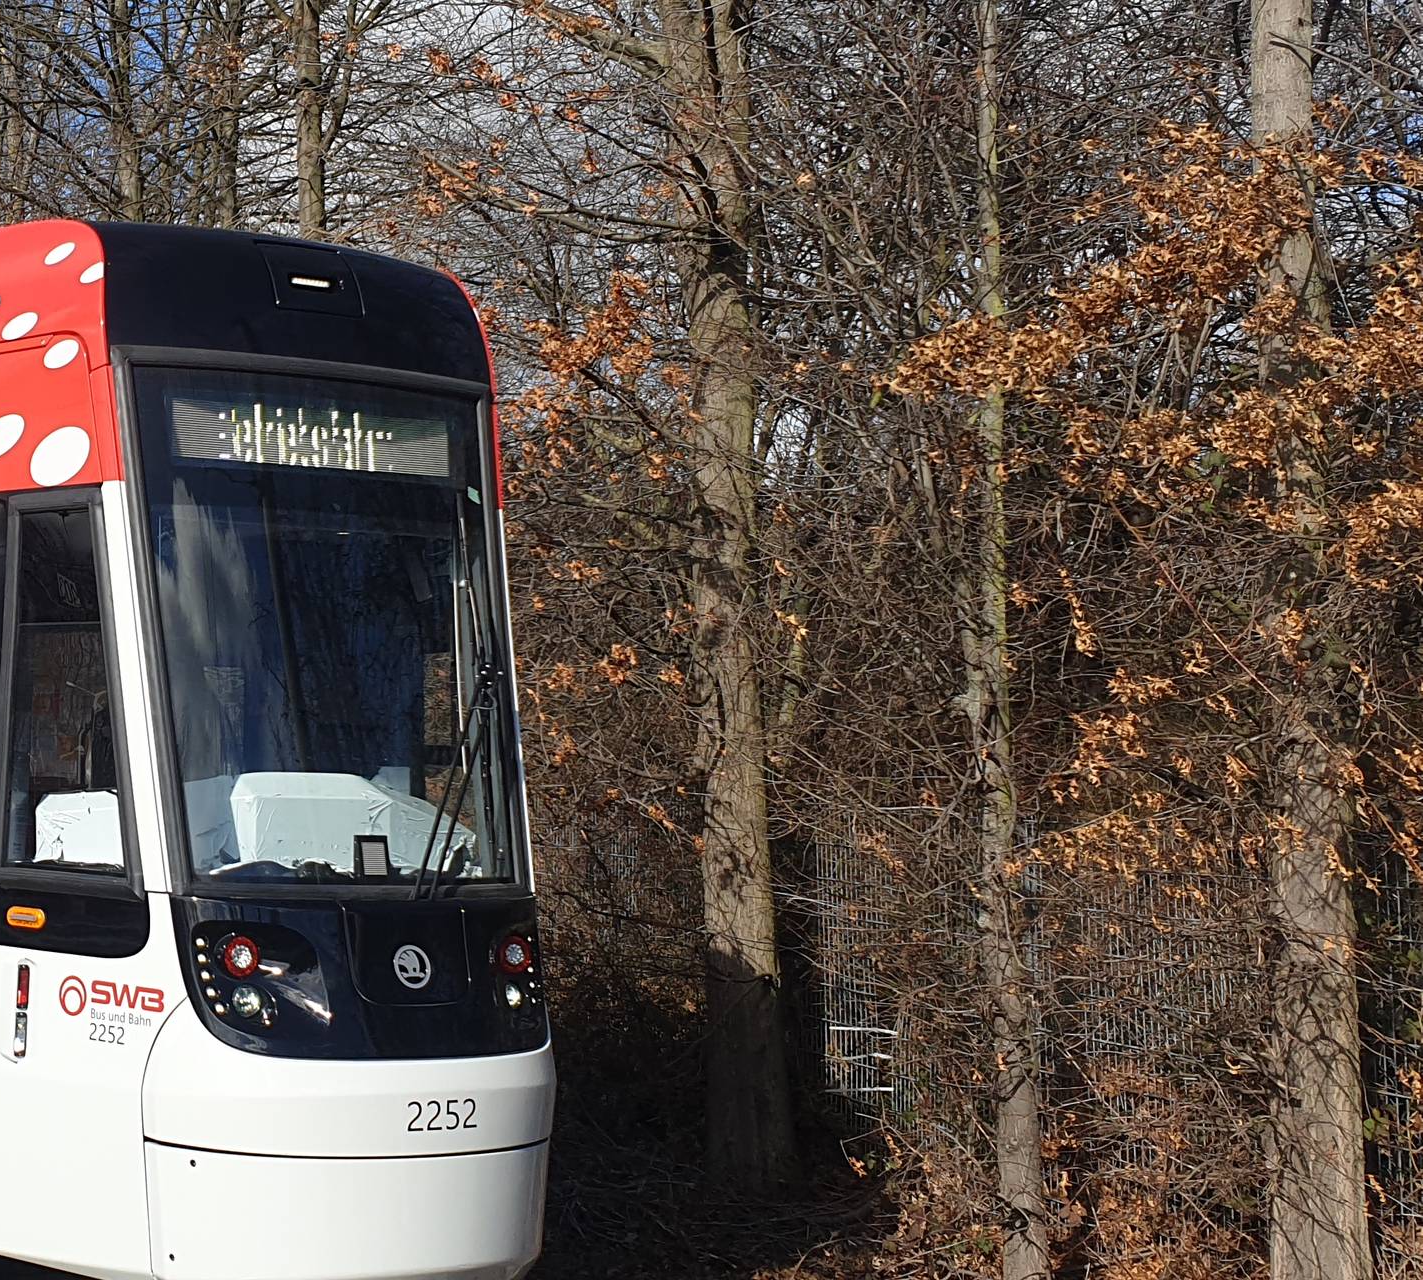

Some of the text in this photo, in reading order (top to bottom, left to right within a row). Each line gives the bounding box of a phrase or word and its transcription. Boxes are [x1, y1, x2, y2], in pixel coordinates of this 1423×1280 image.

[91, 980, 165, 1013] SWB
[90, 1008, 152, 1027] Bus und Bahn
[89, 1022, 125, 1045] 2252
[407, 1098, 477, 1132] 2252
